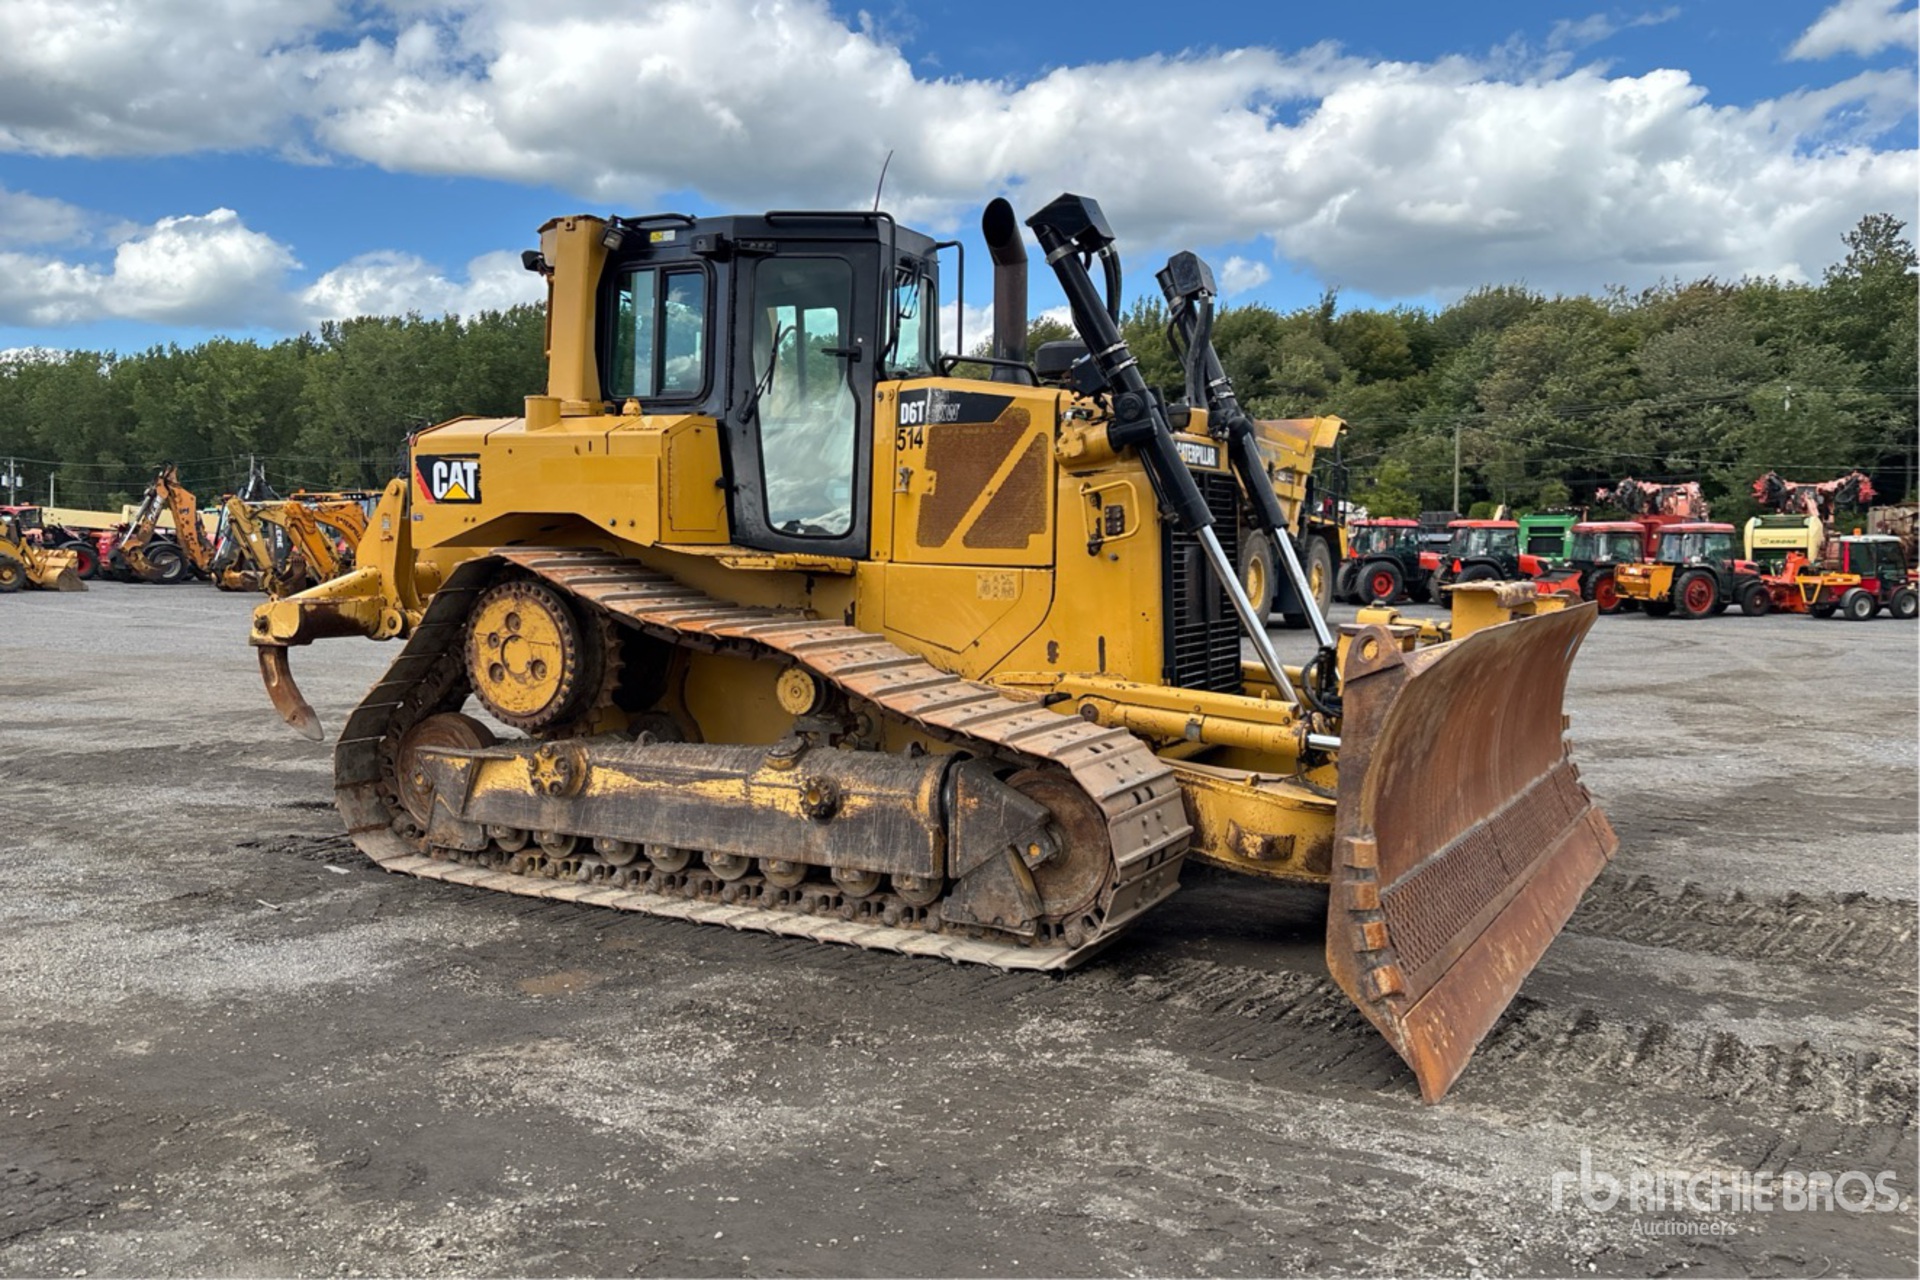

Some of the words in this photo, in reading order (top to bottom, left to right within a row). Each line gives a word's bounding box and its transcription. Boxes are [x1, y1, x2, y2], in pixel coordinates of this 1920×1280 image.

[900, 400, 925, 424] D6T
[897, 427, 924, 452] 514
[432, 460, 479, 500] CAT
